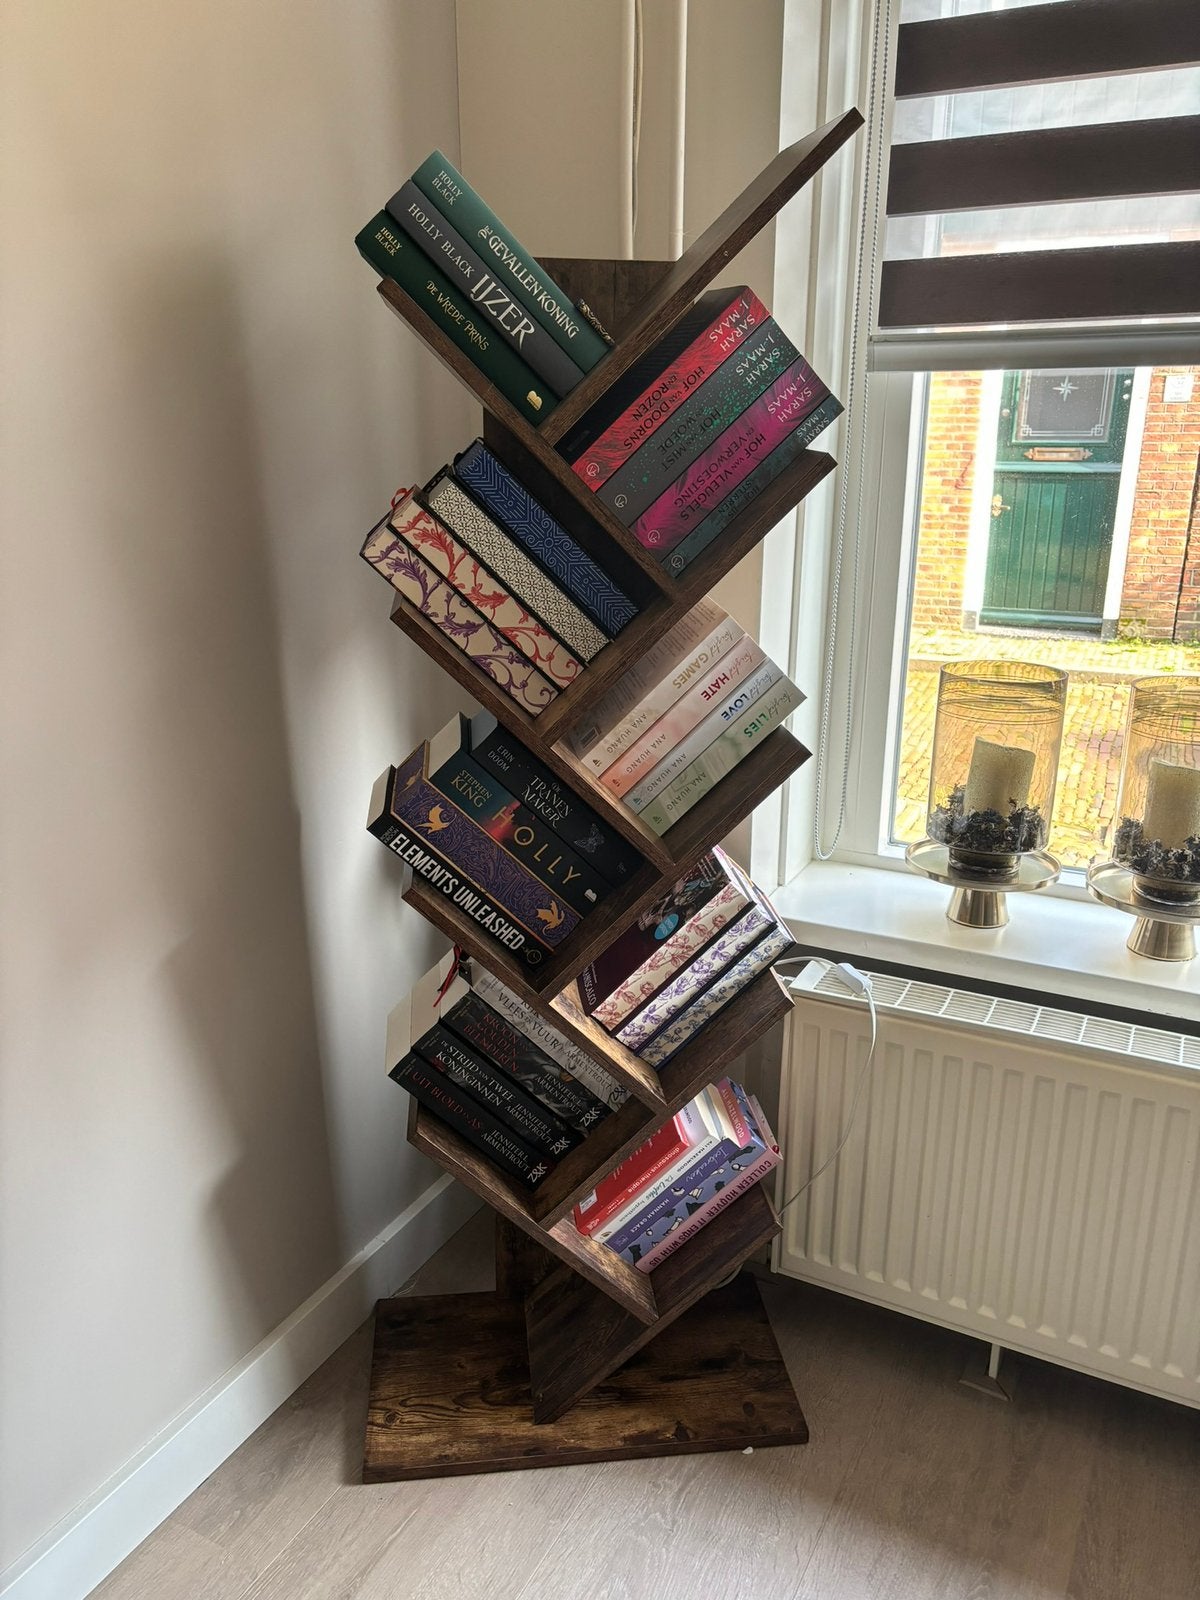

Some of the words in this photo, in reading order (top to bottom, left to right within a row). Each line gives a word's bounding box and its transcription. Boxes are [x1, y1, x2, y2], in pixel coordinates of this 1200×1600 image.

[431, 177, 457, 206] BLACK
[438, 170, 463, 198] HOLLY
[374, 233, 397, 256] BLACK
[380, 226, 402, 250] HOLLY
[407, 203, 443, 241] HOLLY
[441, 240, 476, 279] BLACK
[469, 273, 535, 349] IJZER
[477, 225, 493, 240] DE
[488, 235, 541, 297] GEVALLEN
[536, 291, 580, 339] KONING
[425, 280, 437, 296] DE
[435, 293, 465, 326] WREDE
[463, 320, 490, 351] PRINS
[738, 299, 750, 311] J.
[708, 310, 741, 343] MAAS
[720, 315, 756, 352] SARAH
[765, 333, 776, 345] J.
[735, 344, 768, 378] MAAS
[746, 347, 781, 386] SARAH
[682, 366, 705, 391] HOF
[795, 373, 806, 385] J.
[632, 383, 670, 422] ROZEN
[670, 389, 683, 405] VAN
[767, 383, 799, 415] MAAS
[777, 386, 813, 423] SARAH
[623, 400, 671, 450] DOORNS
[700, 409, 721, 434] HOF
[796, 413, 820, 438] MAAS
[803, 417, 830, 444] SARAH
[657, 417, 696, 456] WOEDE
[744, 433, 766, 459] HOF
[662, 443, 687, 472] MIST
[674, 435, 747, 508] VERWOESTING
[680, 469, 733, 521] VLEUGELS
[718, 480, 752, 514] STERREN
[672, 652, 710, 689] GAMES
[700, 672, 731, 701] HATE
[631, 712, 648, 728] ANA
[721, 692, 749, 722] LOVE
[743, 711, 771, 738] LIES
[496, 744, 516, 763] ERIN
[606, 728, 631, 754] HUANG
[650, 733, 667, 749] ANA
[487, 750, 510, 773] DOOM
[625, 749, 651, 774] HUANG
[671, 753, 687, 770] ANA
[450, 777, 487, 809] KING
[459, 768, 493, 799] STEPHEN
[646, 767, 672, 792] HUANG
[690, 771, 707, 788] ANA
[521, 784, 561, 829] MAKER
[527, 774, 573, 818] TRANEN
[666, 786, 692, 812] HUANG
[491, 805, 582, 885] HOLLY
[388, 833, 459, 895] ELEMENTS
[452, 886, 526, 951] UNLEASHED
[497, 992, 526, 1020] VLEES
[532, 1021, 560, 1049] VUUR
[435, 1050, 502, 1107] KONINGINNEN
[448, 1045, 480, 1074] STRIJD
[487, 1078, 515, 1102] TWEE
[566, 1050, 613, 1089] ARMENTROUT
[534, 1075, 583, 1117] ARMENTROUT
[543, 1072, 578, 1102] JENNIFER
[504, 1105, 554, 1144] ARMENTROUT
[513, 1103, 548, 1131] JENNIFER
[579, 1108, 601, 1129] Z&K
[726, 1100, 745, 1138] HAZELWOOD
[480, 1132, 530, 1172] ARMENTROUT
[490, 1129, 525, 1159] JENNIFER
[549, 1136, 571, 1155] Z&K
[704, 1140, 713, 1149] ALI
[526, 1162, 548, 1183] Z&K
[676, 1147, 705, 1173] HAZELWOOD
[685, 1145, 730, 1182] Icebreaker
[739, 1160, 772, 1191] COLLEEN
[647, 1198, 670, 1219] HANNAH
[706, 1188, 739, 1217] HOOVER
[630, 1217, 648, 1233] GRACE
[699, 1217, 707, 1227] IT
[649, 1256, 661, 1267] US
[660, 1240, 681, 1258] WITH
